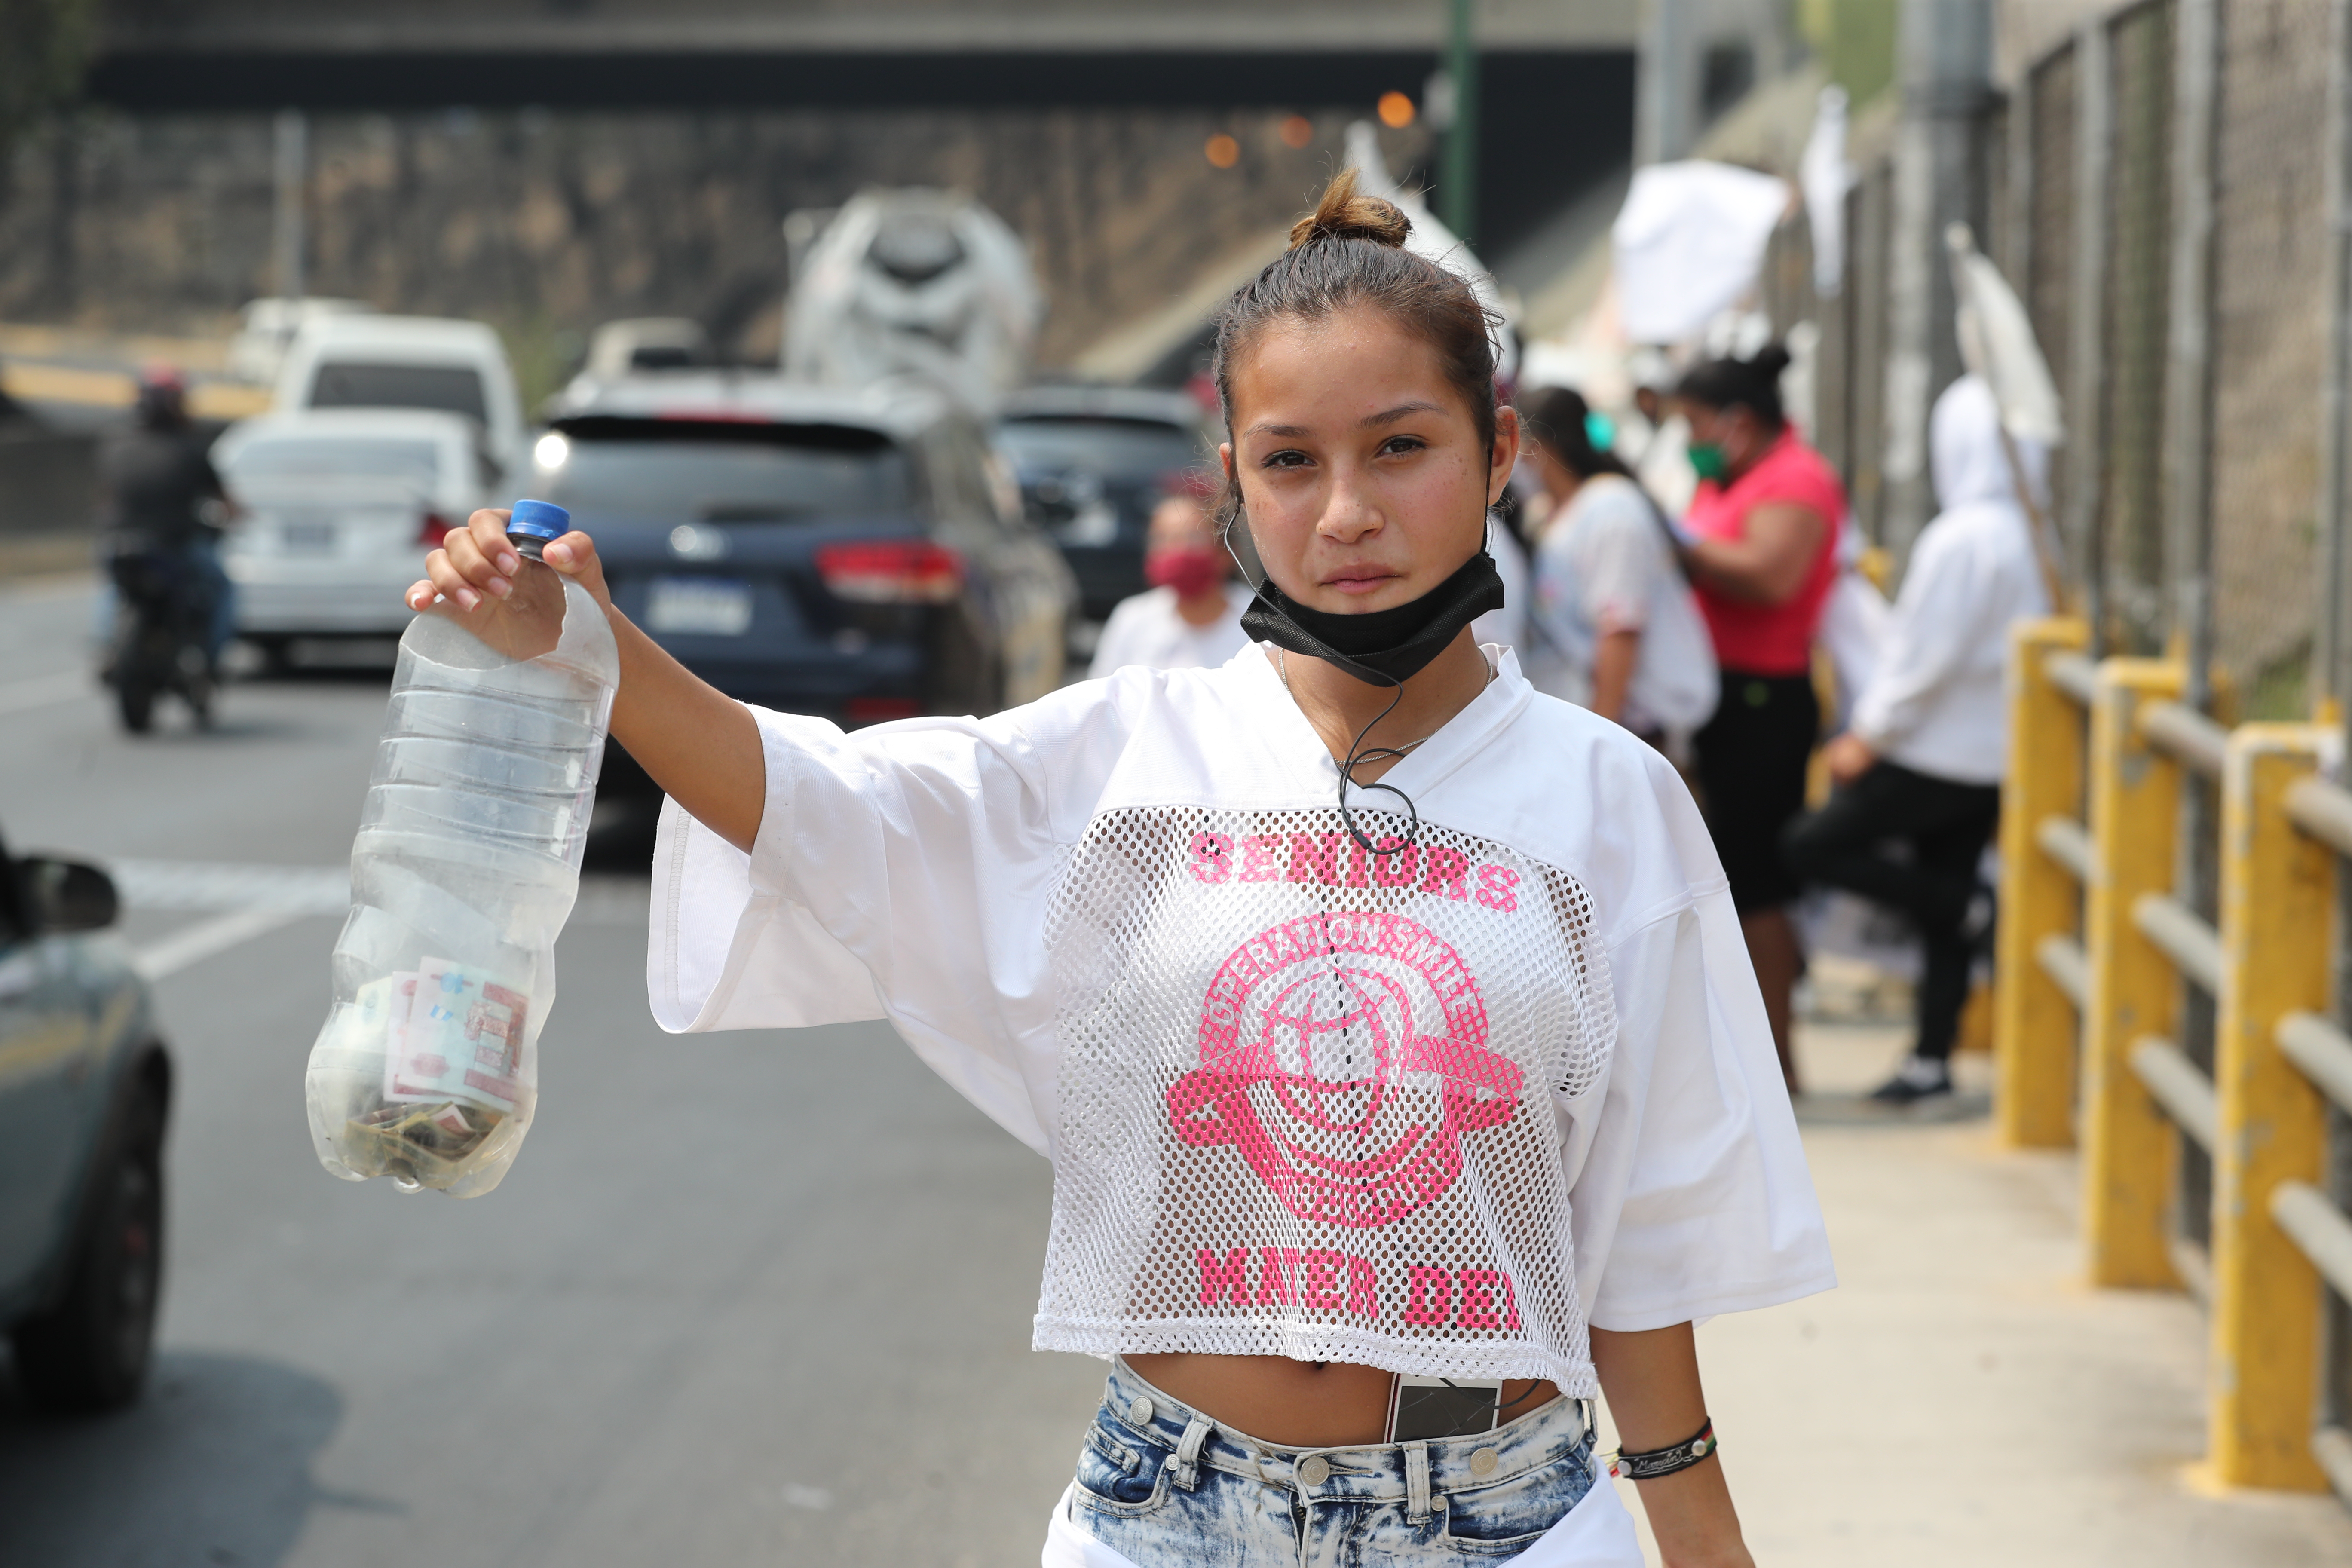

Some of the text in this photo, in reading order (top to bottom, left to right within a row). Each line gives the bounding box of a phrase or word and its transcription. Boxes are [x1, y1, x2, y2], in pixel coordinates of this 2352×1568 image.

[1188, 830, 1520, 913] SENIORS
[1211, 917, 1479, 1027] OPERATION SMILE
[1196, 1247, 1520, 1329] MATER DEI
